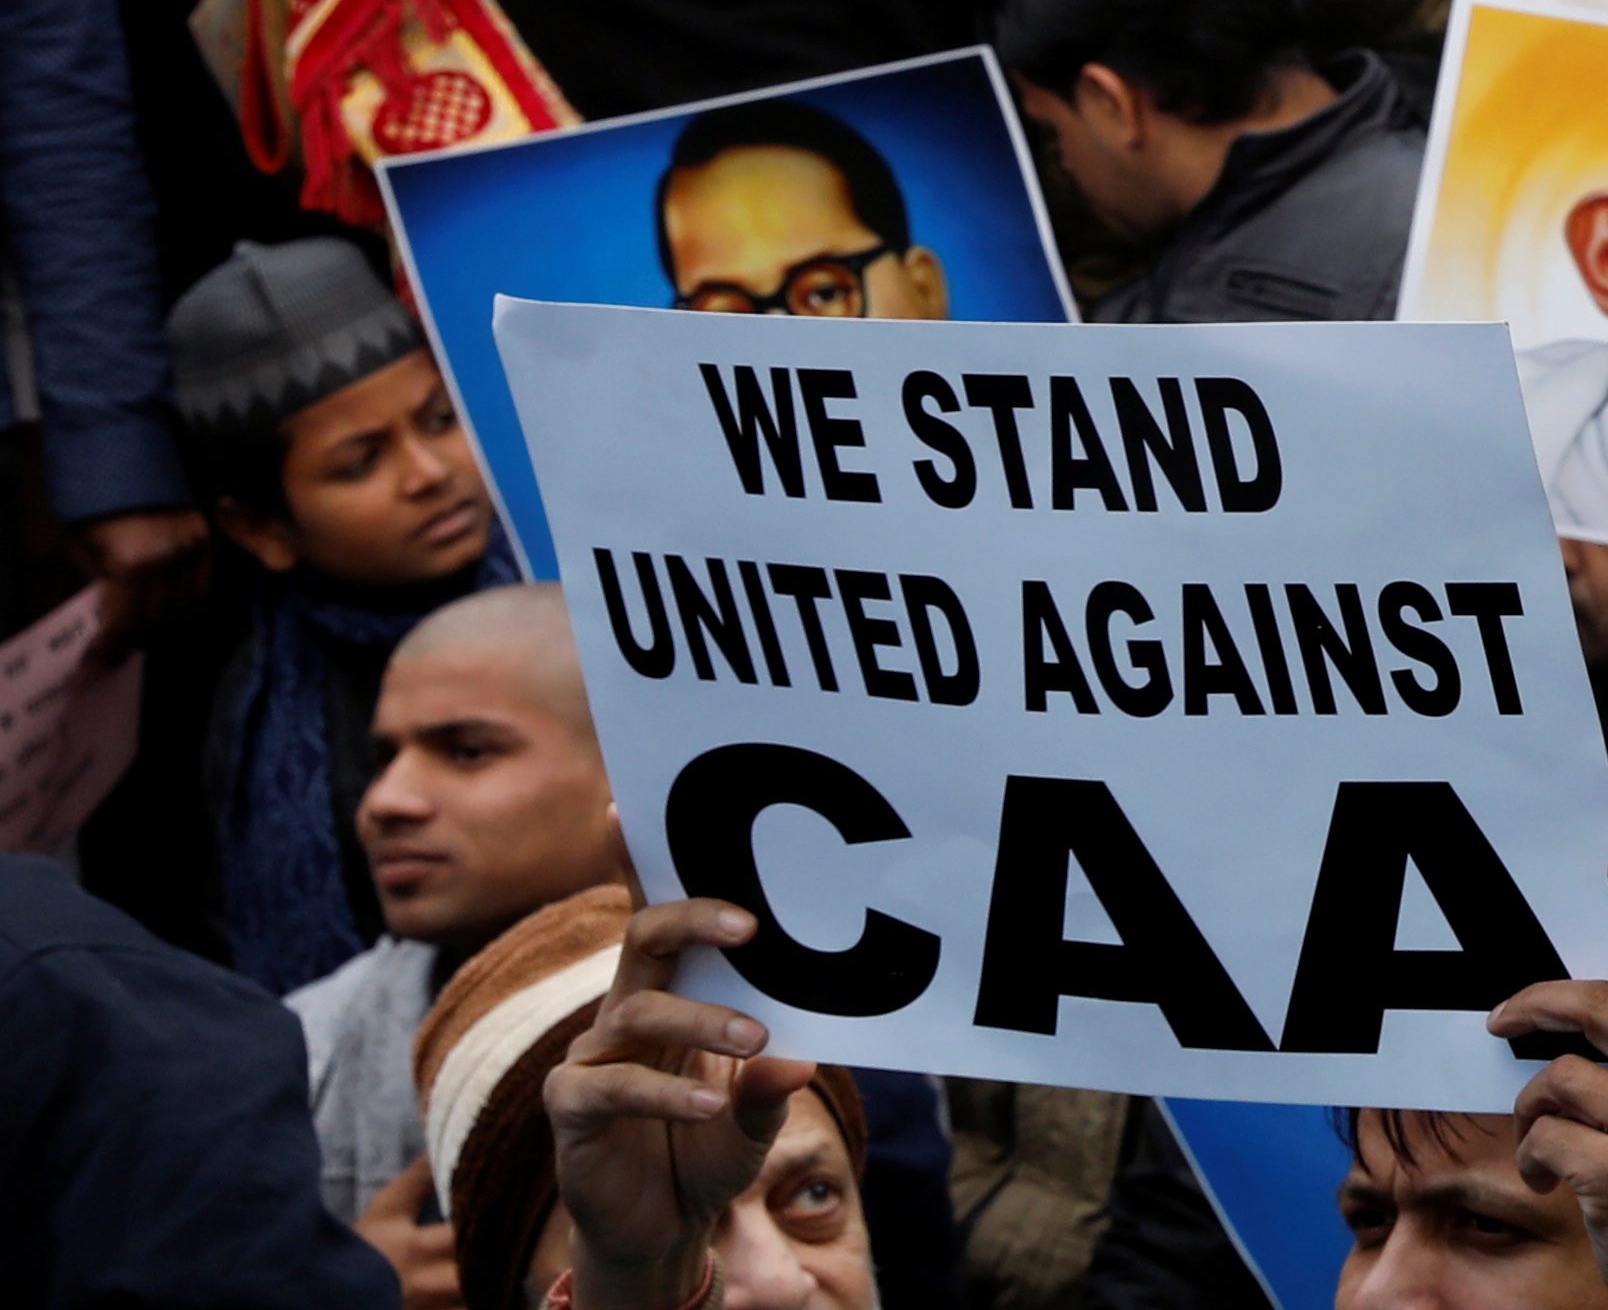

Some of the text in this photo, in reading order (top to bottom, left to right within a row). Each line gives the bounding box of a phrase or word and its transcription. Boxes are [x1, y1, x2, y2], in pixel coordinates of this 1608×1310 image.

[699, 362, 1284, 514] WE STAND
[593, 546, 1525, 719] UNITED AGAINST
